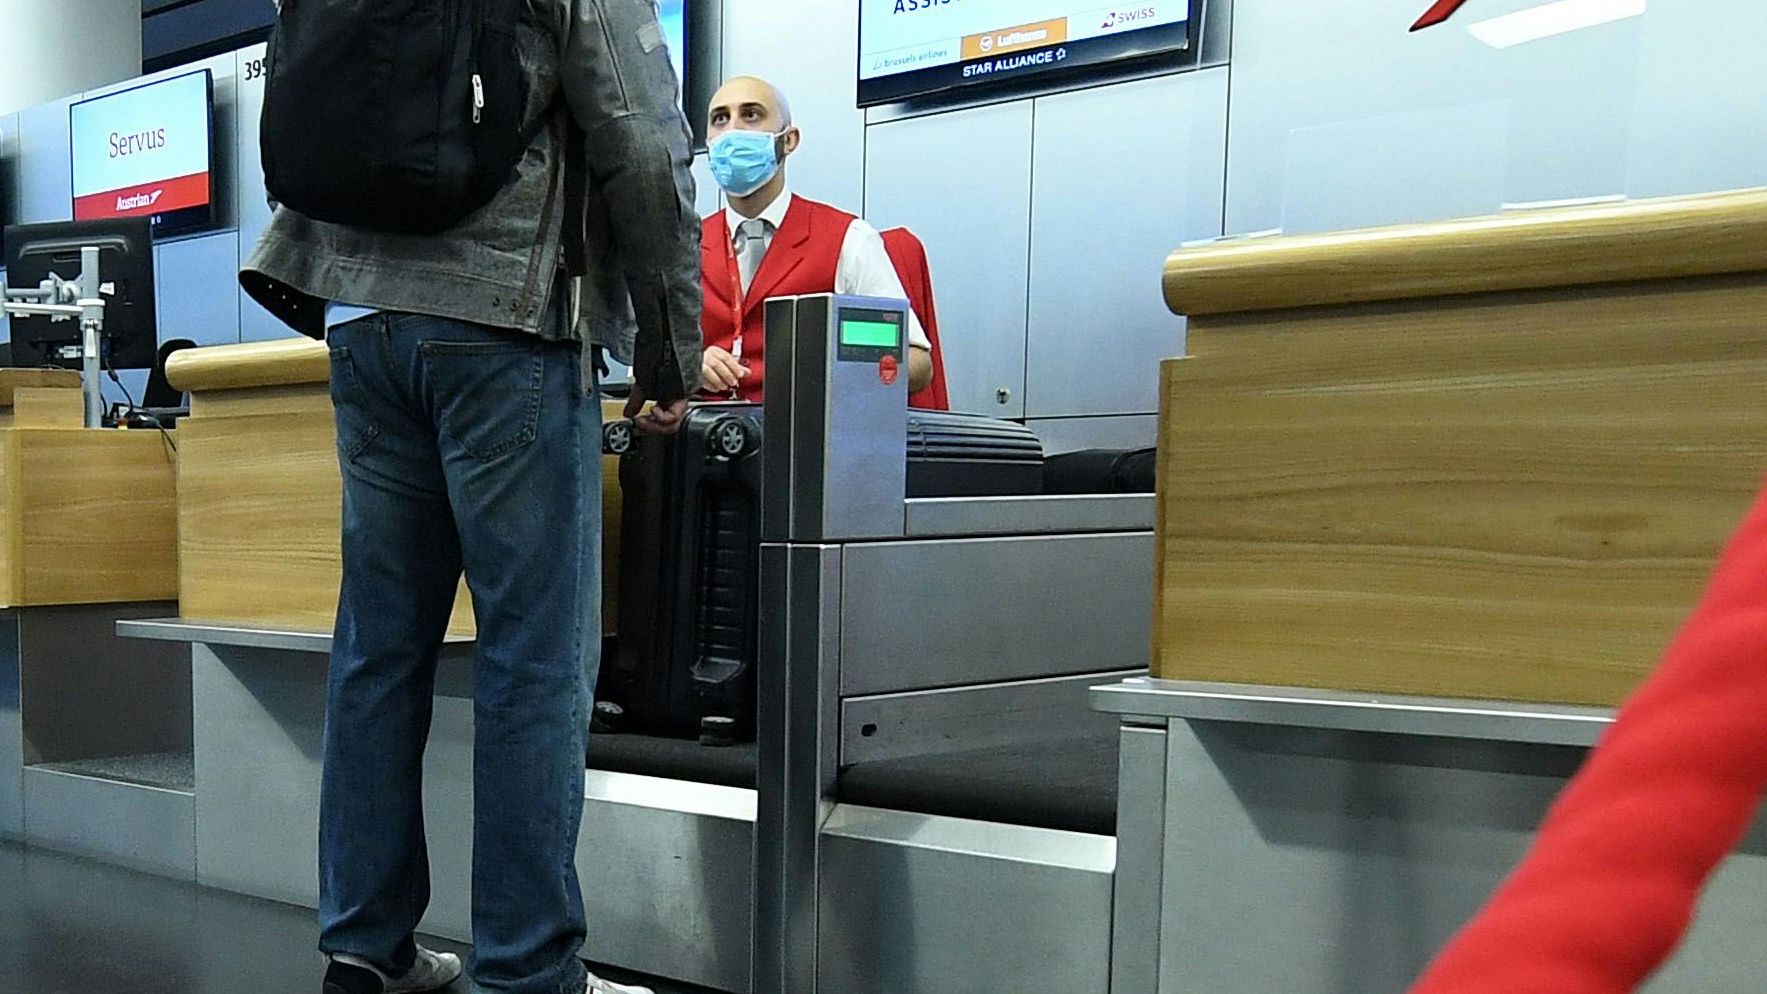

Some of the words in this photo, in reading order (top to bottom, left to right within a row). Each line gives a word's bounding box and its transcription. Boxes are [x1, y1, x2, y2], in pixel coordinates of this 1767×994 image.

[1117, 7, 1156, 24] SWISS
[884, 54, 916, 68] brussels
[962, 62, 993, 78] STAR
[994, 50, 1054, 72] ALLIANCE
[109, 127, 165, 159] Servus
